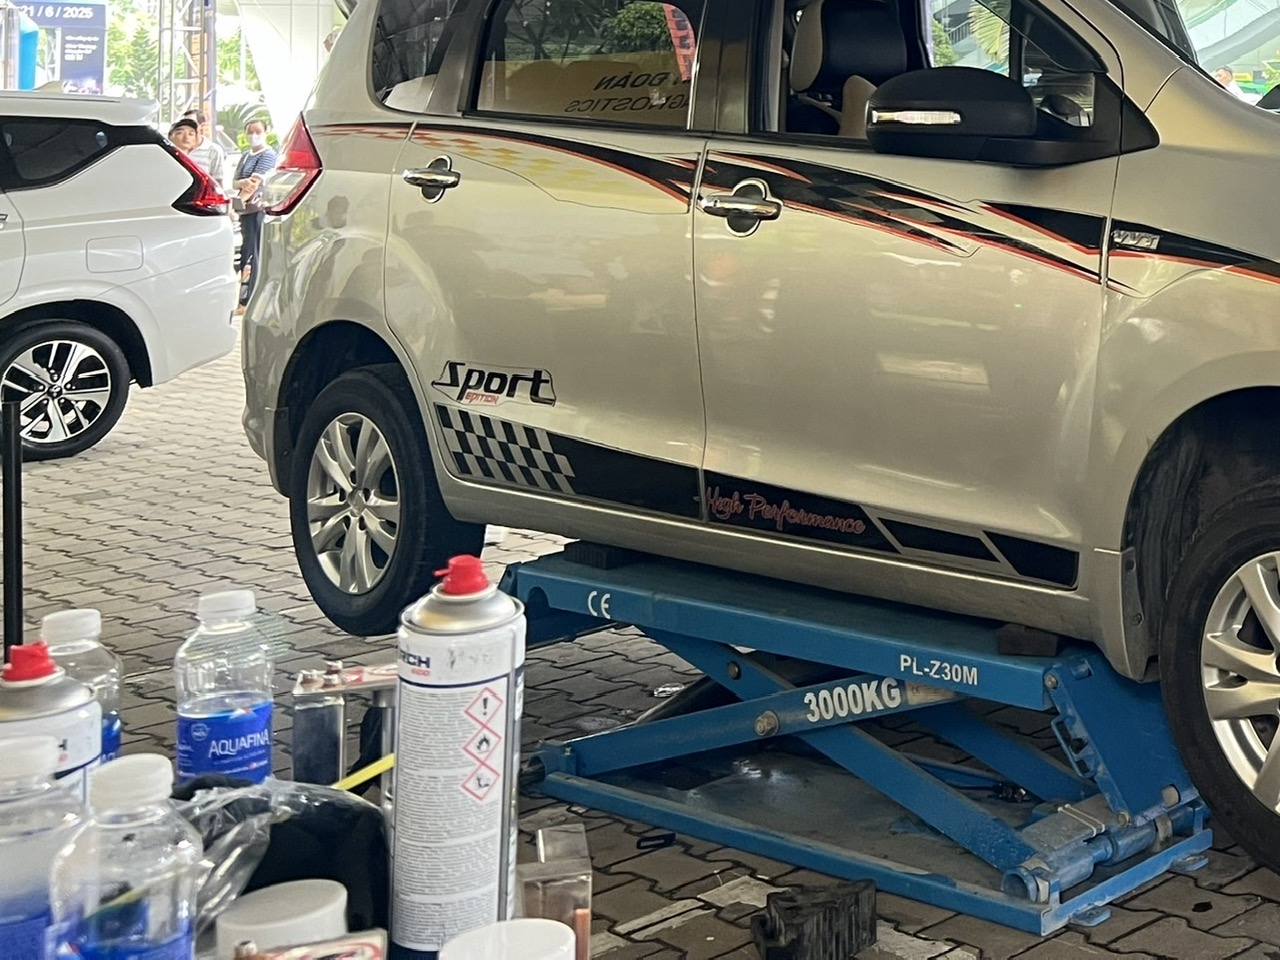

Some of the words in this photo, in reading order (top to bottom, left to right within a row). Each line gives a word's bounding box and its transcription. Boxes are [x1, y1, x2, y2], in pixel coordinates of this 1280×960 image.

[431, 361, 557, 407] Sport
[694, 486, 744, 520] High
[743, 493, 866, 535] Performance
[900, 654, 978, 686] PL-Z30M
[803, 677, 901, 723] 3000KG
[208, 728, 271, 758] AQUAFINA
